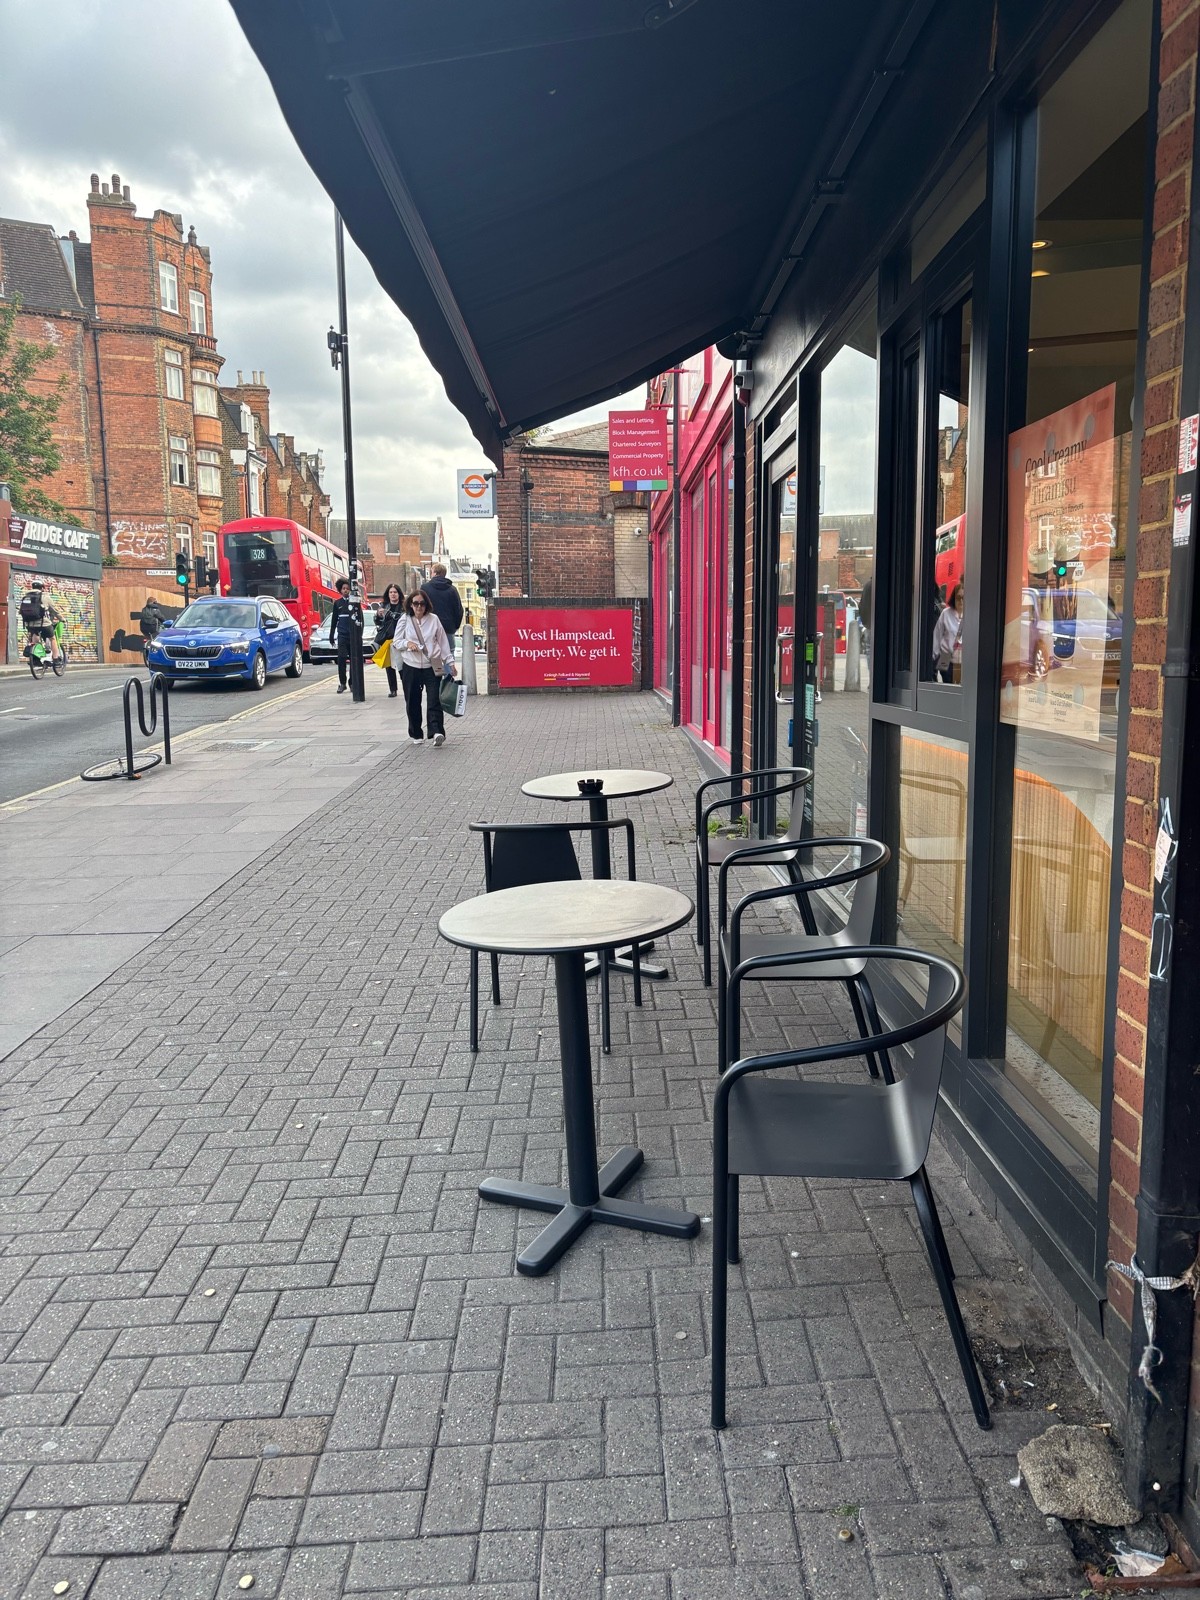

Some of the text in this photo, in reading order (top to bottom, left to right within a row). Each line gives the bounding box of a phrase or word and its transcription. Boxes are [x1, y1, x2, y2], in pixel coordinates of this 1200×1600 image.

[613, 465, 664, 477] kfh.co.uk
[1032, 476, 1077, 506] Tiramisu
[64, 530, 89, 550] CAFE
[253, 549, 265, 559] 328
[517, 628, 615, 643] West Hampstead.
[512, 646, 621, 661] Property. We get it.
